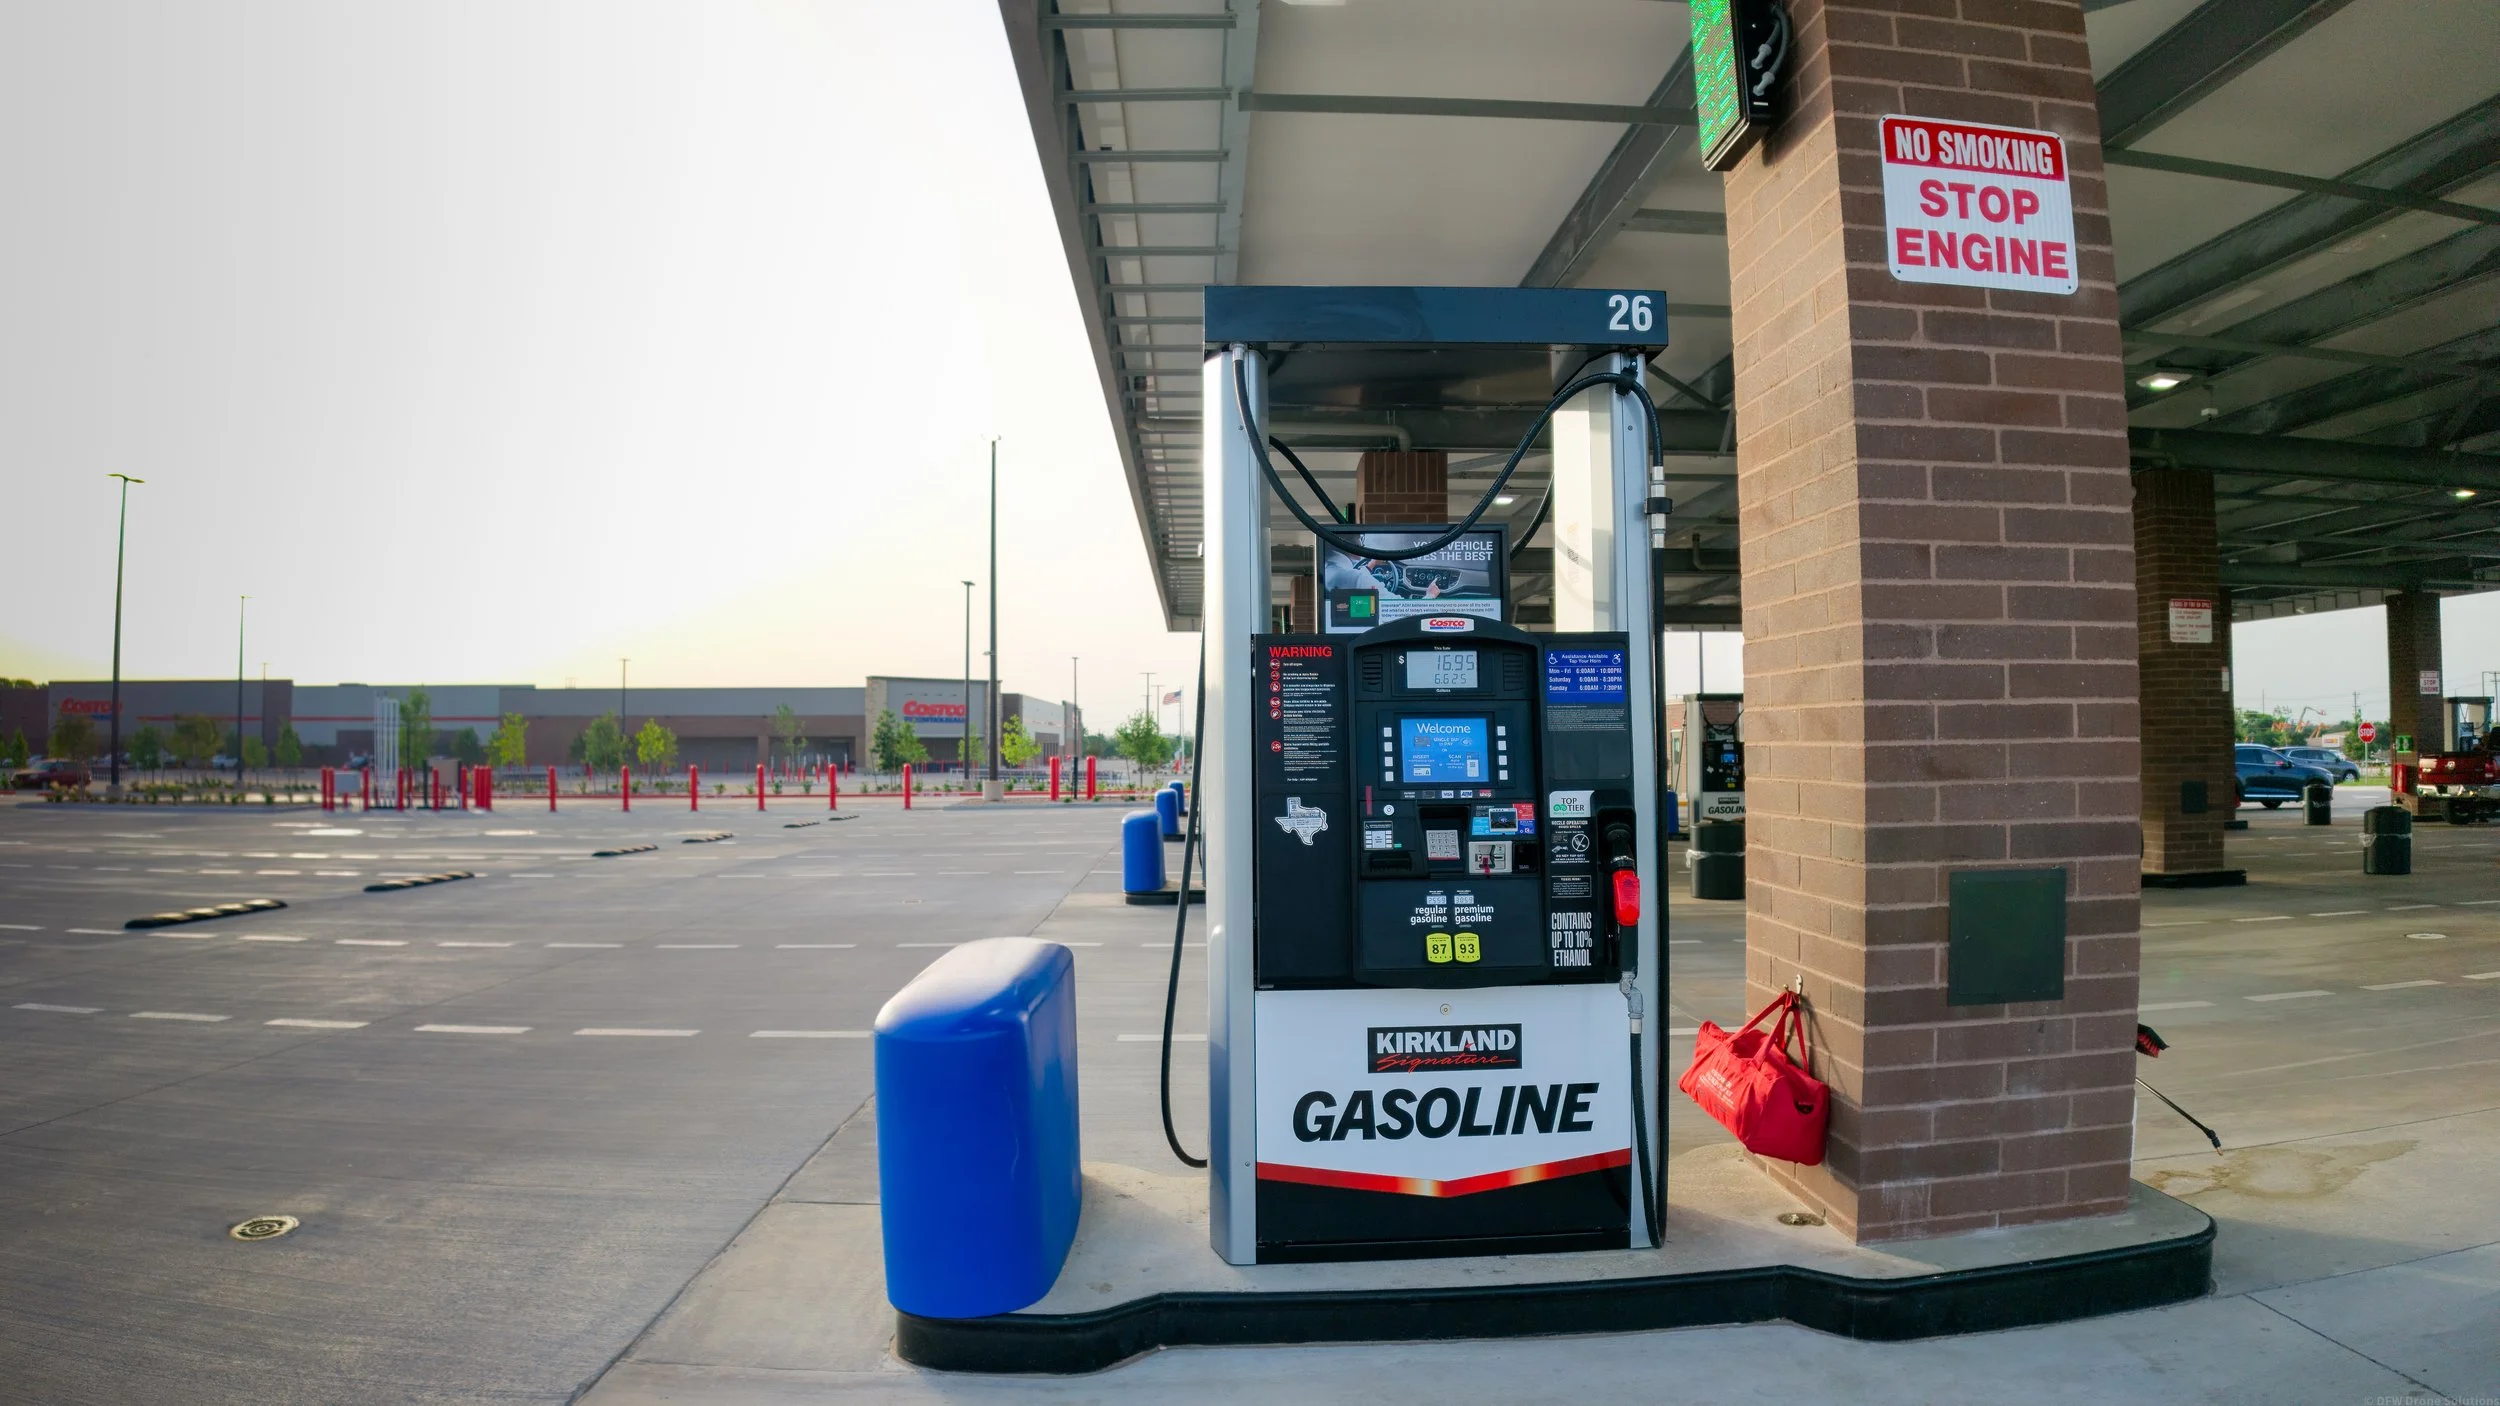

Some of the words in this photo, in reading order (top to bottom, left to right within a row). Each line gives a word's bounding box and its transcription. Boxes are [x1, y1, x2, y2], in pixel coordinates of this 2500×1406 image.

[1895, 126, 1932, 161] NO
[1938, 130, 2054, 176] SMOKING
[1920, 179, 2040, 225] STOP
[1896, 227, 2070, 280] ENGINE
[1608, 295, 1653, 332] 26
[1447, 541, 1493, 551] VEHICLE
[1440, 551, 1462, 561] THE
[1464, 551, 1493, 561] BEST
[1429, 619, 1465, 627] COSTCO
[1269, 646, 1333, 657] WARNING
[1398, 655, 1405, 664] $
[1436, 654, 1475, 671] 16.95
[1416, 723, 1471, 734] Welcome
[2360, 728, 2375, 736] STOP
[1561, 797, 1577, 805] TOP
[1567, 804, 1585, 812] TIER
[1708, 806, 1746, 814] GASOLIN
[1415, 904, 1447, 917] regular
[1454, 904, 1494, 915] premium
[1410, 914, 1448, 925] gasoline
[1455, 914, 1492, 925] gasoline
[1551, 912, 1592, 930] CONTAINS
[1551, 931, 1563, 949] UP
[1564, 931, 1573, 949] TO
[1575, 931, 1592, 949] 10%
[1432, 944, 1447, 954] 87
[1459, 943, 1475, 954] 93
[1553, 949, 1592, 967] ETHANOL
[1376, 1029, 1516, 1054] KIRKLAND
[1376, 1053, 1516, 1074] Signature
[1292, 1082, 1600, 1143] GASOLINE
